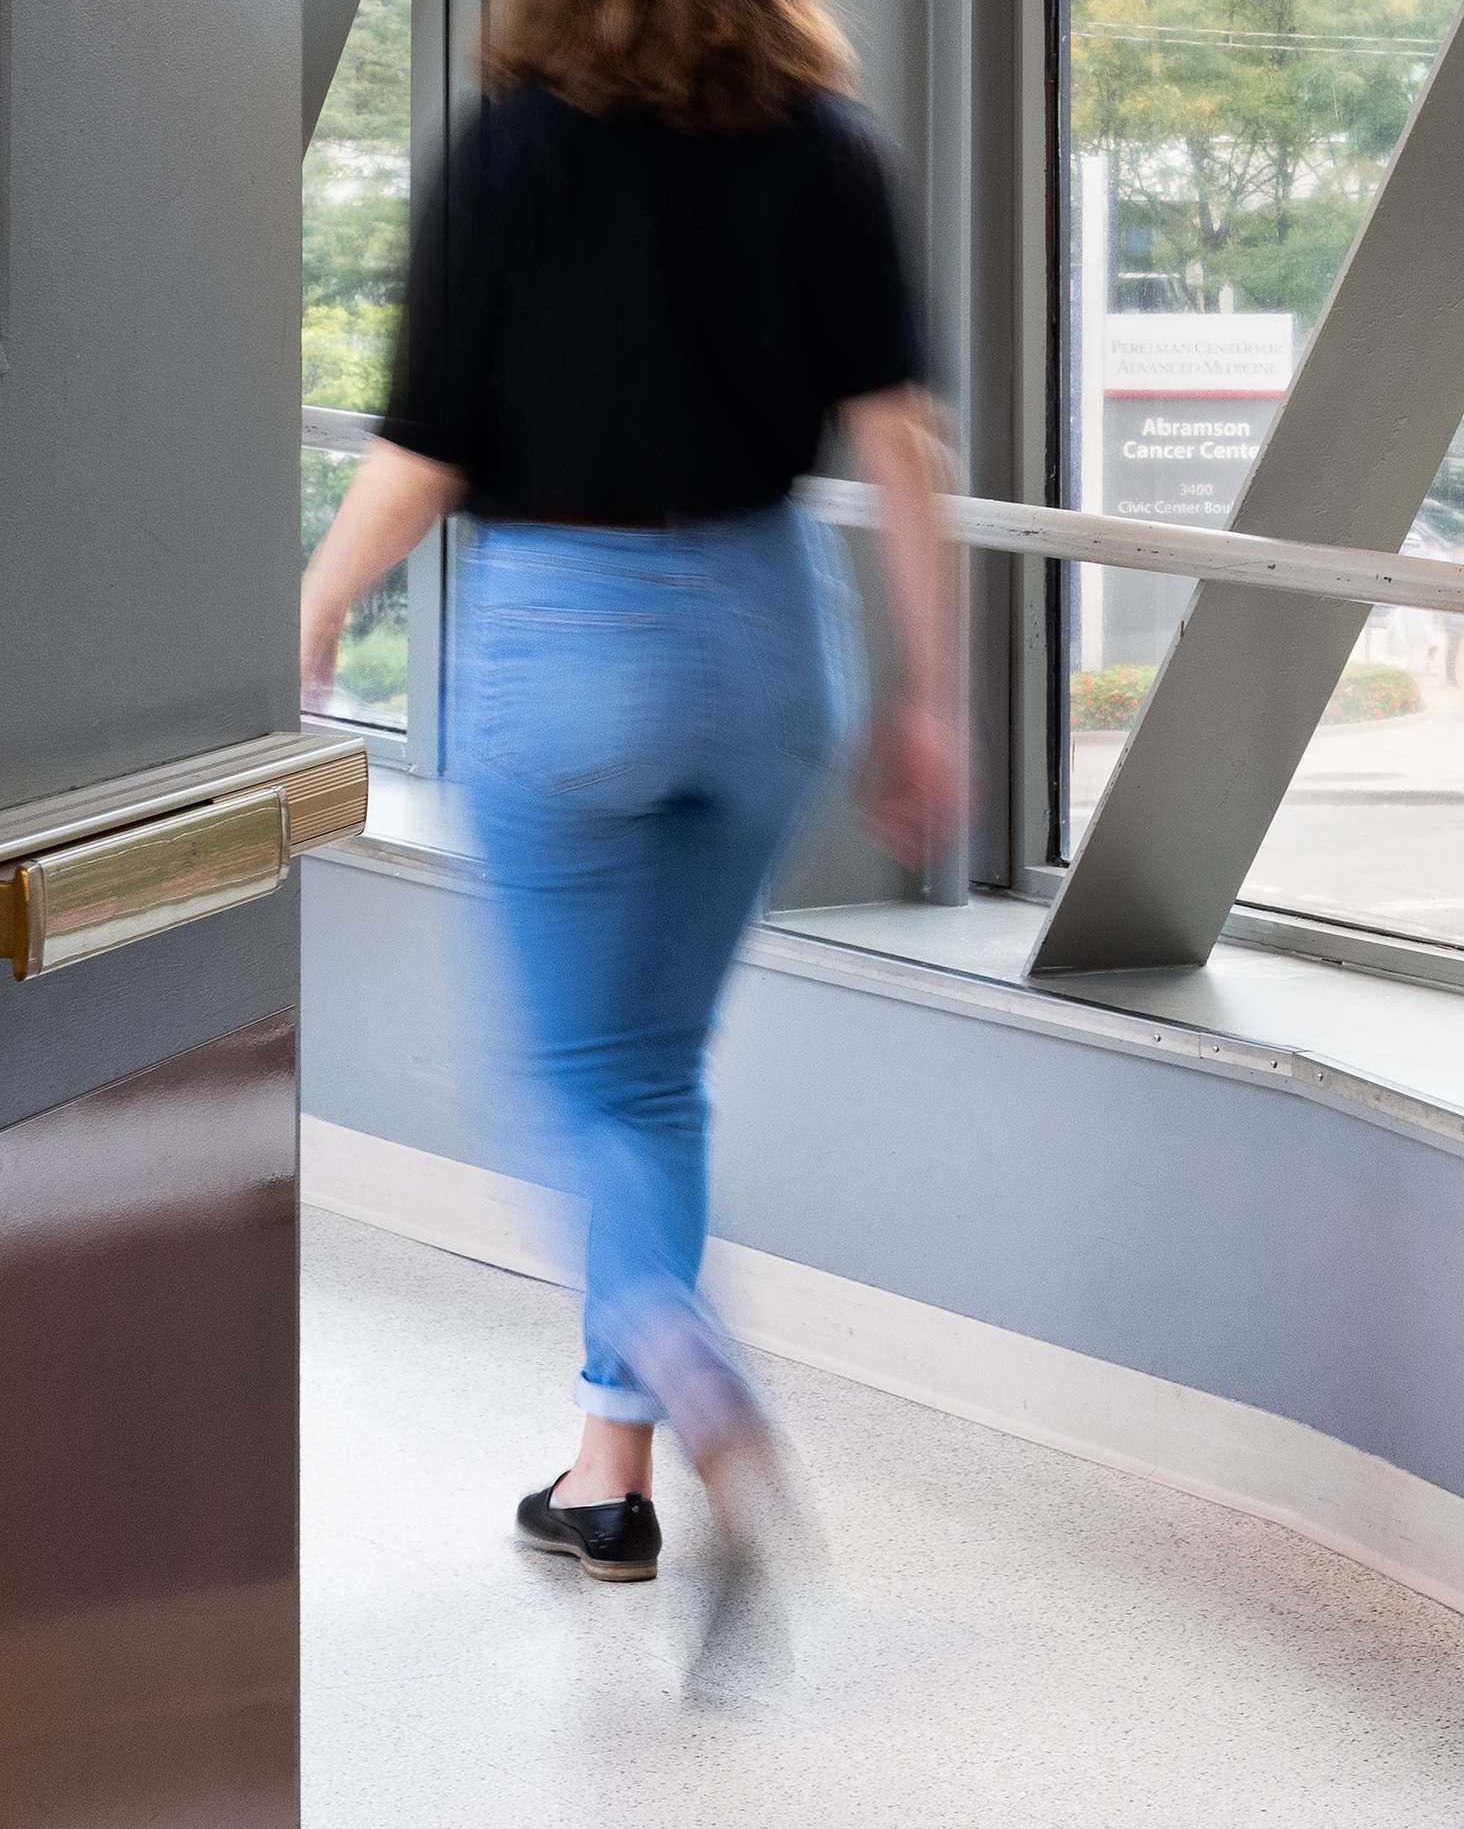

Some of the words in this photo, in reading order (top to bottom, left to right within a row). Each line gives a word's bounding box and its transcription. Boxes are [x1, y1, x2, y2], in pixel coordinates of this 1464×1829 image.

[1111, 339, 1191, 354] PERELMAN
[1194, 339, 1252, 354] CENTER
[1255, 343, 1282, 355] FOR
[1117, 359, 1200, 374] ADVANCED
[1203, 359, 1278, 374] MEDICINE
[1142, 417, 1250, 437] Abramson
[1122, 441, 1195, 460] Cancer
[1200, 441, 1260, 460] Cente
[1179, 482, 1213, 497] 3400
[1118, 500, 1151, 515] Civic
[1154, 500, 1200, 515] Center
[1204, 500, 1235, 515] Bou
